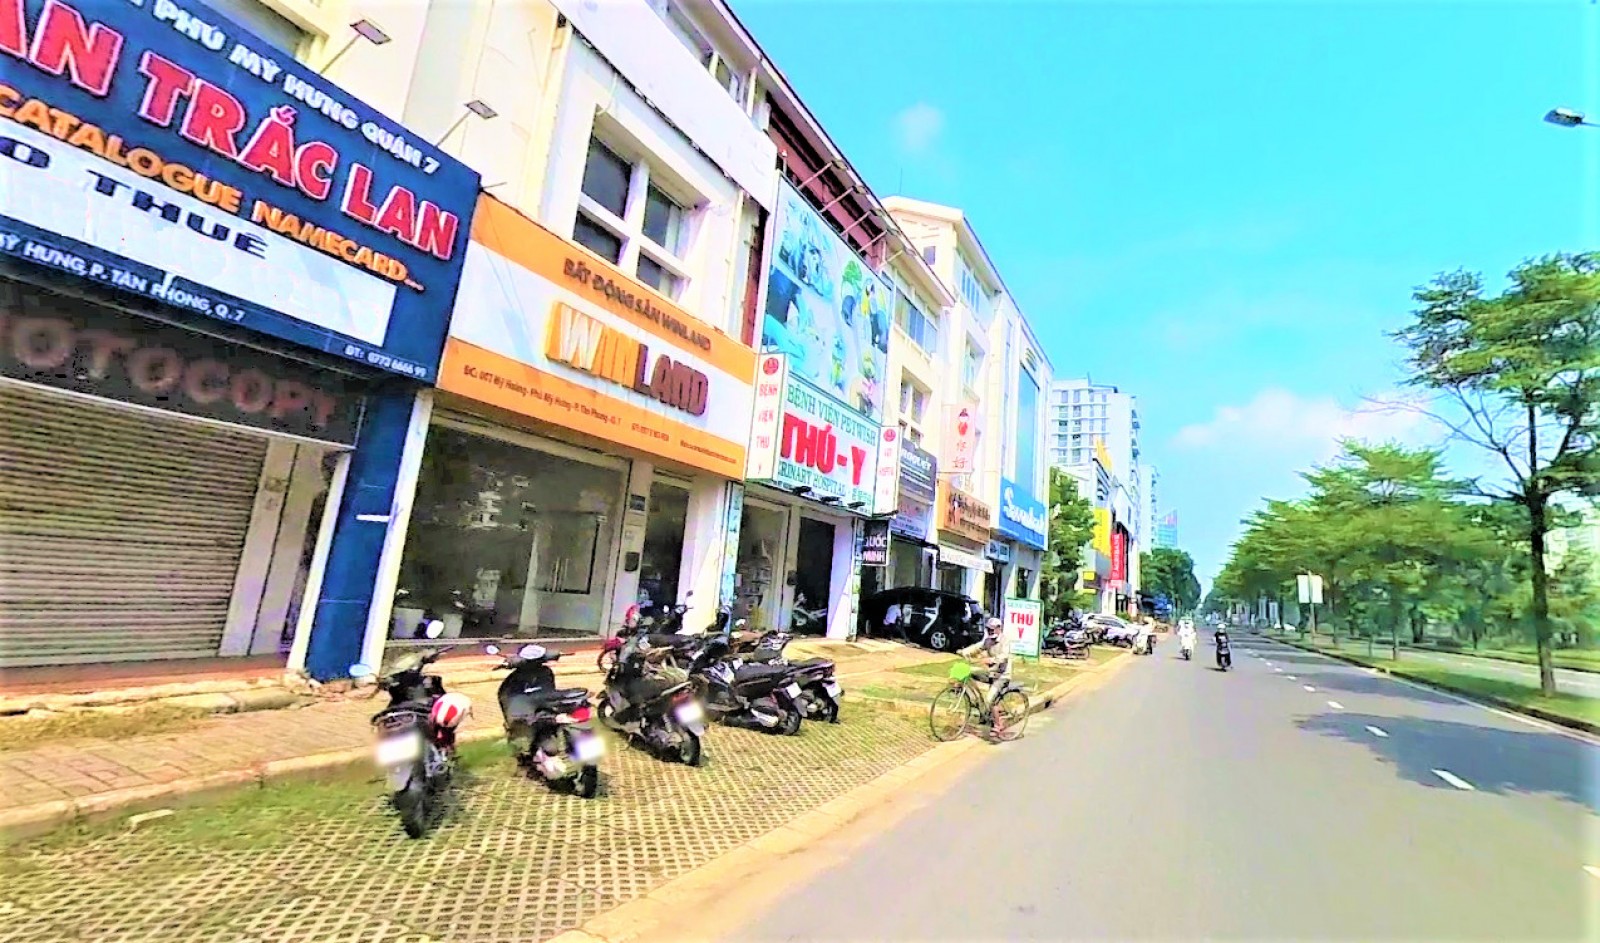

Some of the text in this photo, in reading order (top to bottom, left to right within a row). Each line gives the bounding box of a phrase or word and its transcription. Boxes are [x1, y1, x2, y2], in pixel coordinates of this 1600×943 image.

[0, 83, 244, 214] CATALOGUE
[138, 50, 338, 200] TRẮC
[340, 162, 459, 260] LAN
[421, 155, 441, 175] 7
[545, 301, 709, 417] WINLAND
[660, 312, 712, 351] WINLAND
